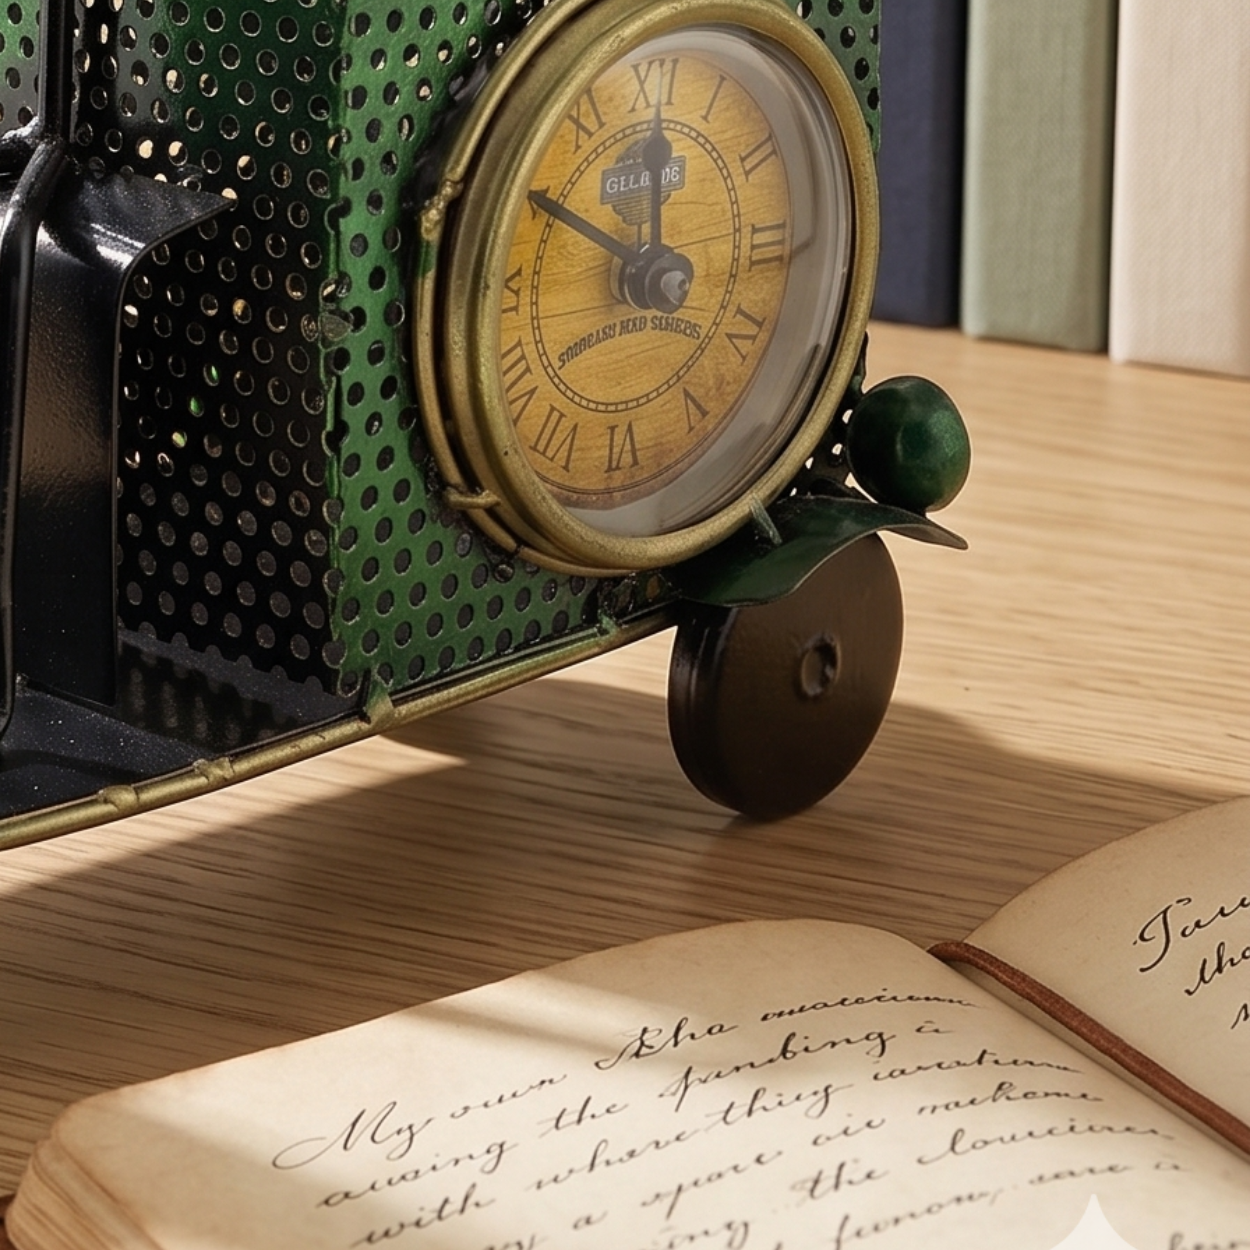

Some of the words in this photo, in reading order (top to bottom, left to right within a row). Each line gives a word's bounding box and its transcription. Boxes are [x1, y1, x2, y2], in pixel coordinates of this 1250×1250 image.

[566, 86, 607, 155] XI
[699, 74, 728, 125] I
[738, 131, 779, 183] II
[748, 218, 787, 272] III
[724, 303, 767, 366] IV
[681, 386, 710, 435] V
[528, 403, 579, 474] VII
[603, 420, 640, 474] VI
[271, 1101, 436, 1170] My
